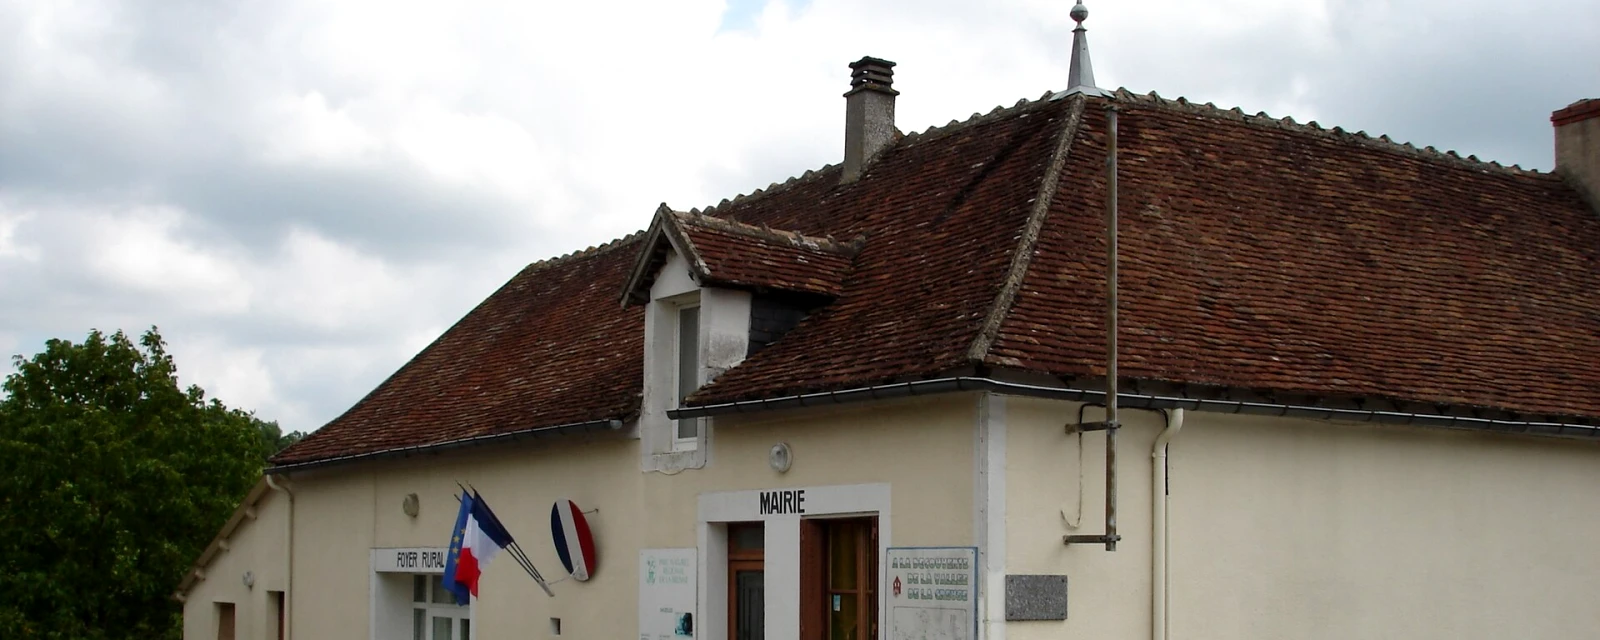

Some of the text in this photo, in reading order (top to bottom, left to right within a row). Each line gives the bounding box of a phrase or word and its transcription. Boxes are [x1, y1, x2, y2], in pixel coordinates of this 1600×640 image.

[760, 490, 805, 515] MAIRIE
[397, 552, 445, 568] FOYER RURAL
[892, 557, 898, 569] A
[900, 557, 911, 569] LA
[907, 573, 968, 585] DE LA VALLEE
[908, 588, 919, 600] DE
[921, 588, 933, 600] LA
